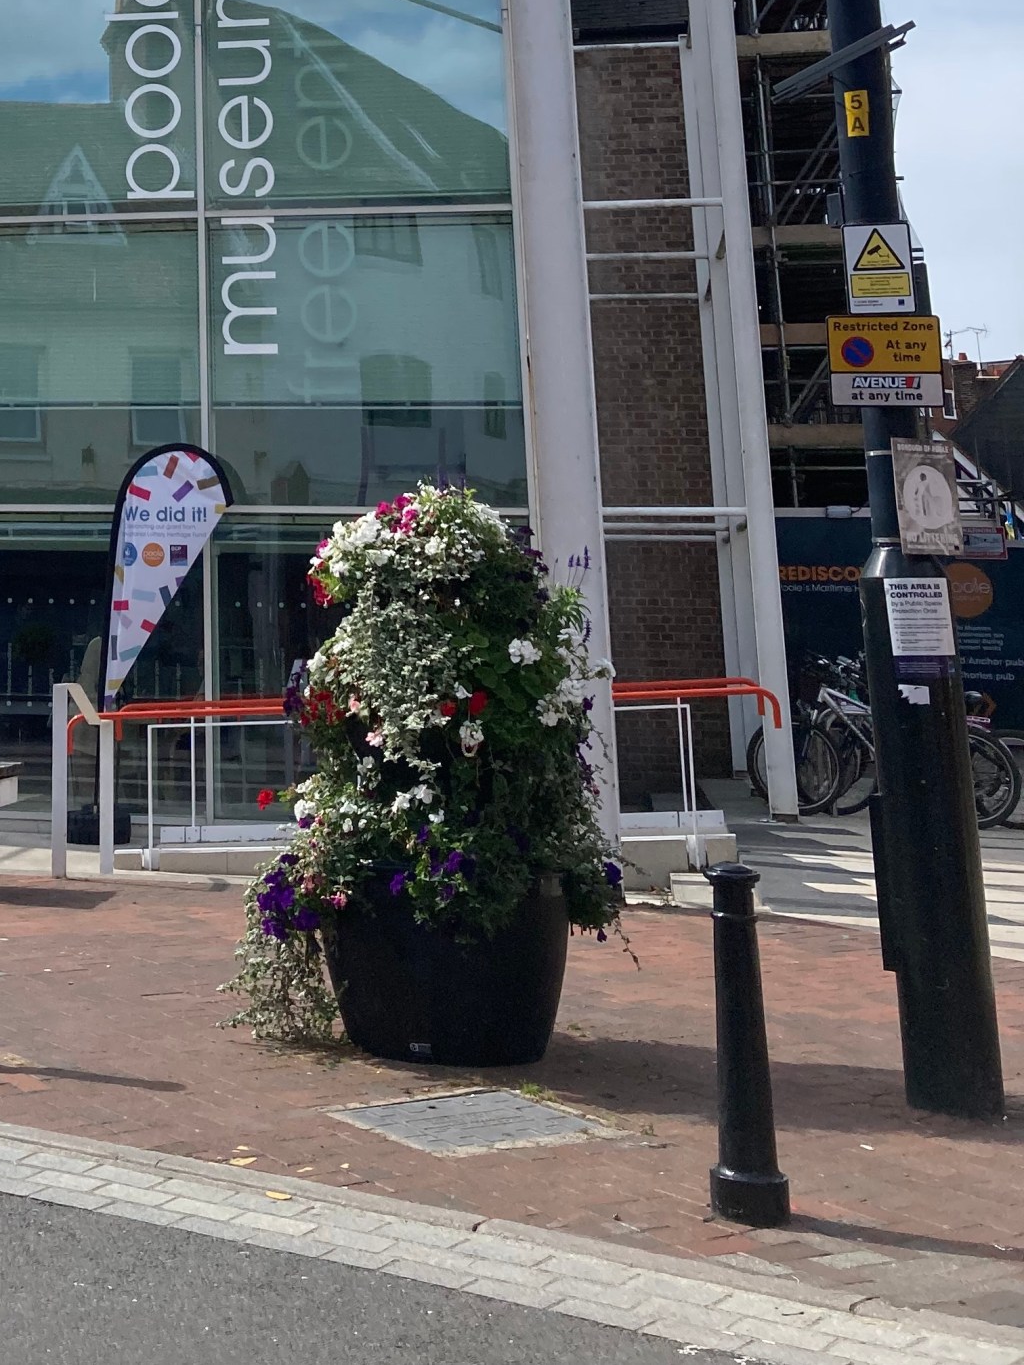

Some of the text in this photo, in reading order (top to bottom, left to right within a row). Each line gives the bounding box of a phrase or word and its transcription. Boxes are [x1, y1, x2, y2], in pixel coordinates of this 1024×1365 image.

[850, 94, 863, 110] 5
[851, 116, 865, 132] A
[833, 321, 934, 332] Restricted Zone
[886, 340, 927, 351] At any
[893, 353, 921, 362] time
[853, 377, 907, 388] AVENUE
[851, 390, 923, 402] at any time
[125, 506, 207, 522] We did it!
[779, 565, 863, 582] REDISCO
[781, 584, 810, 592] oole's
[951, 578, 991, 595] oole
